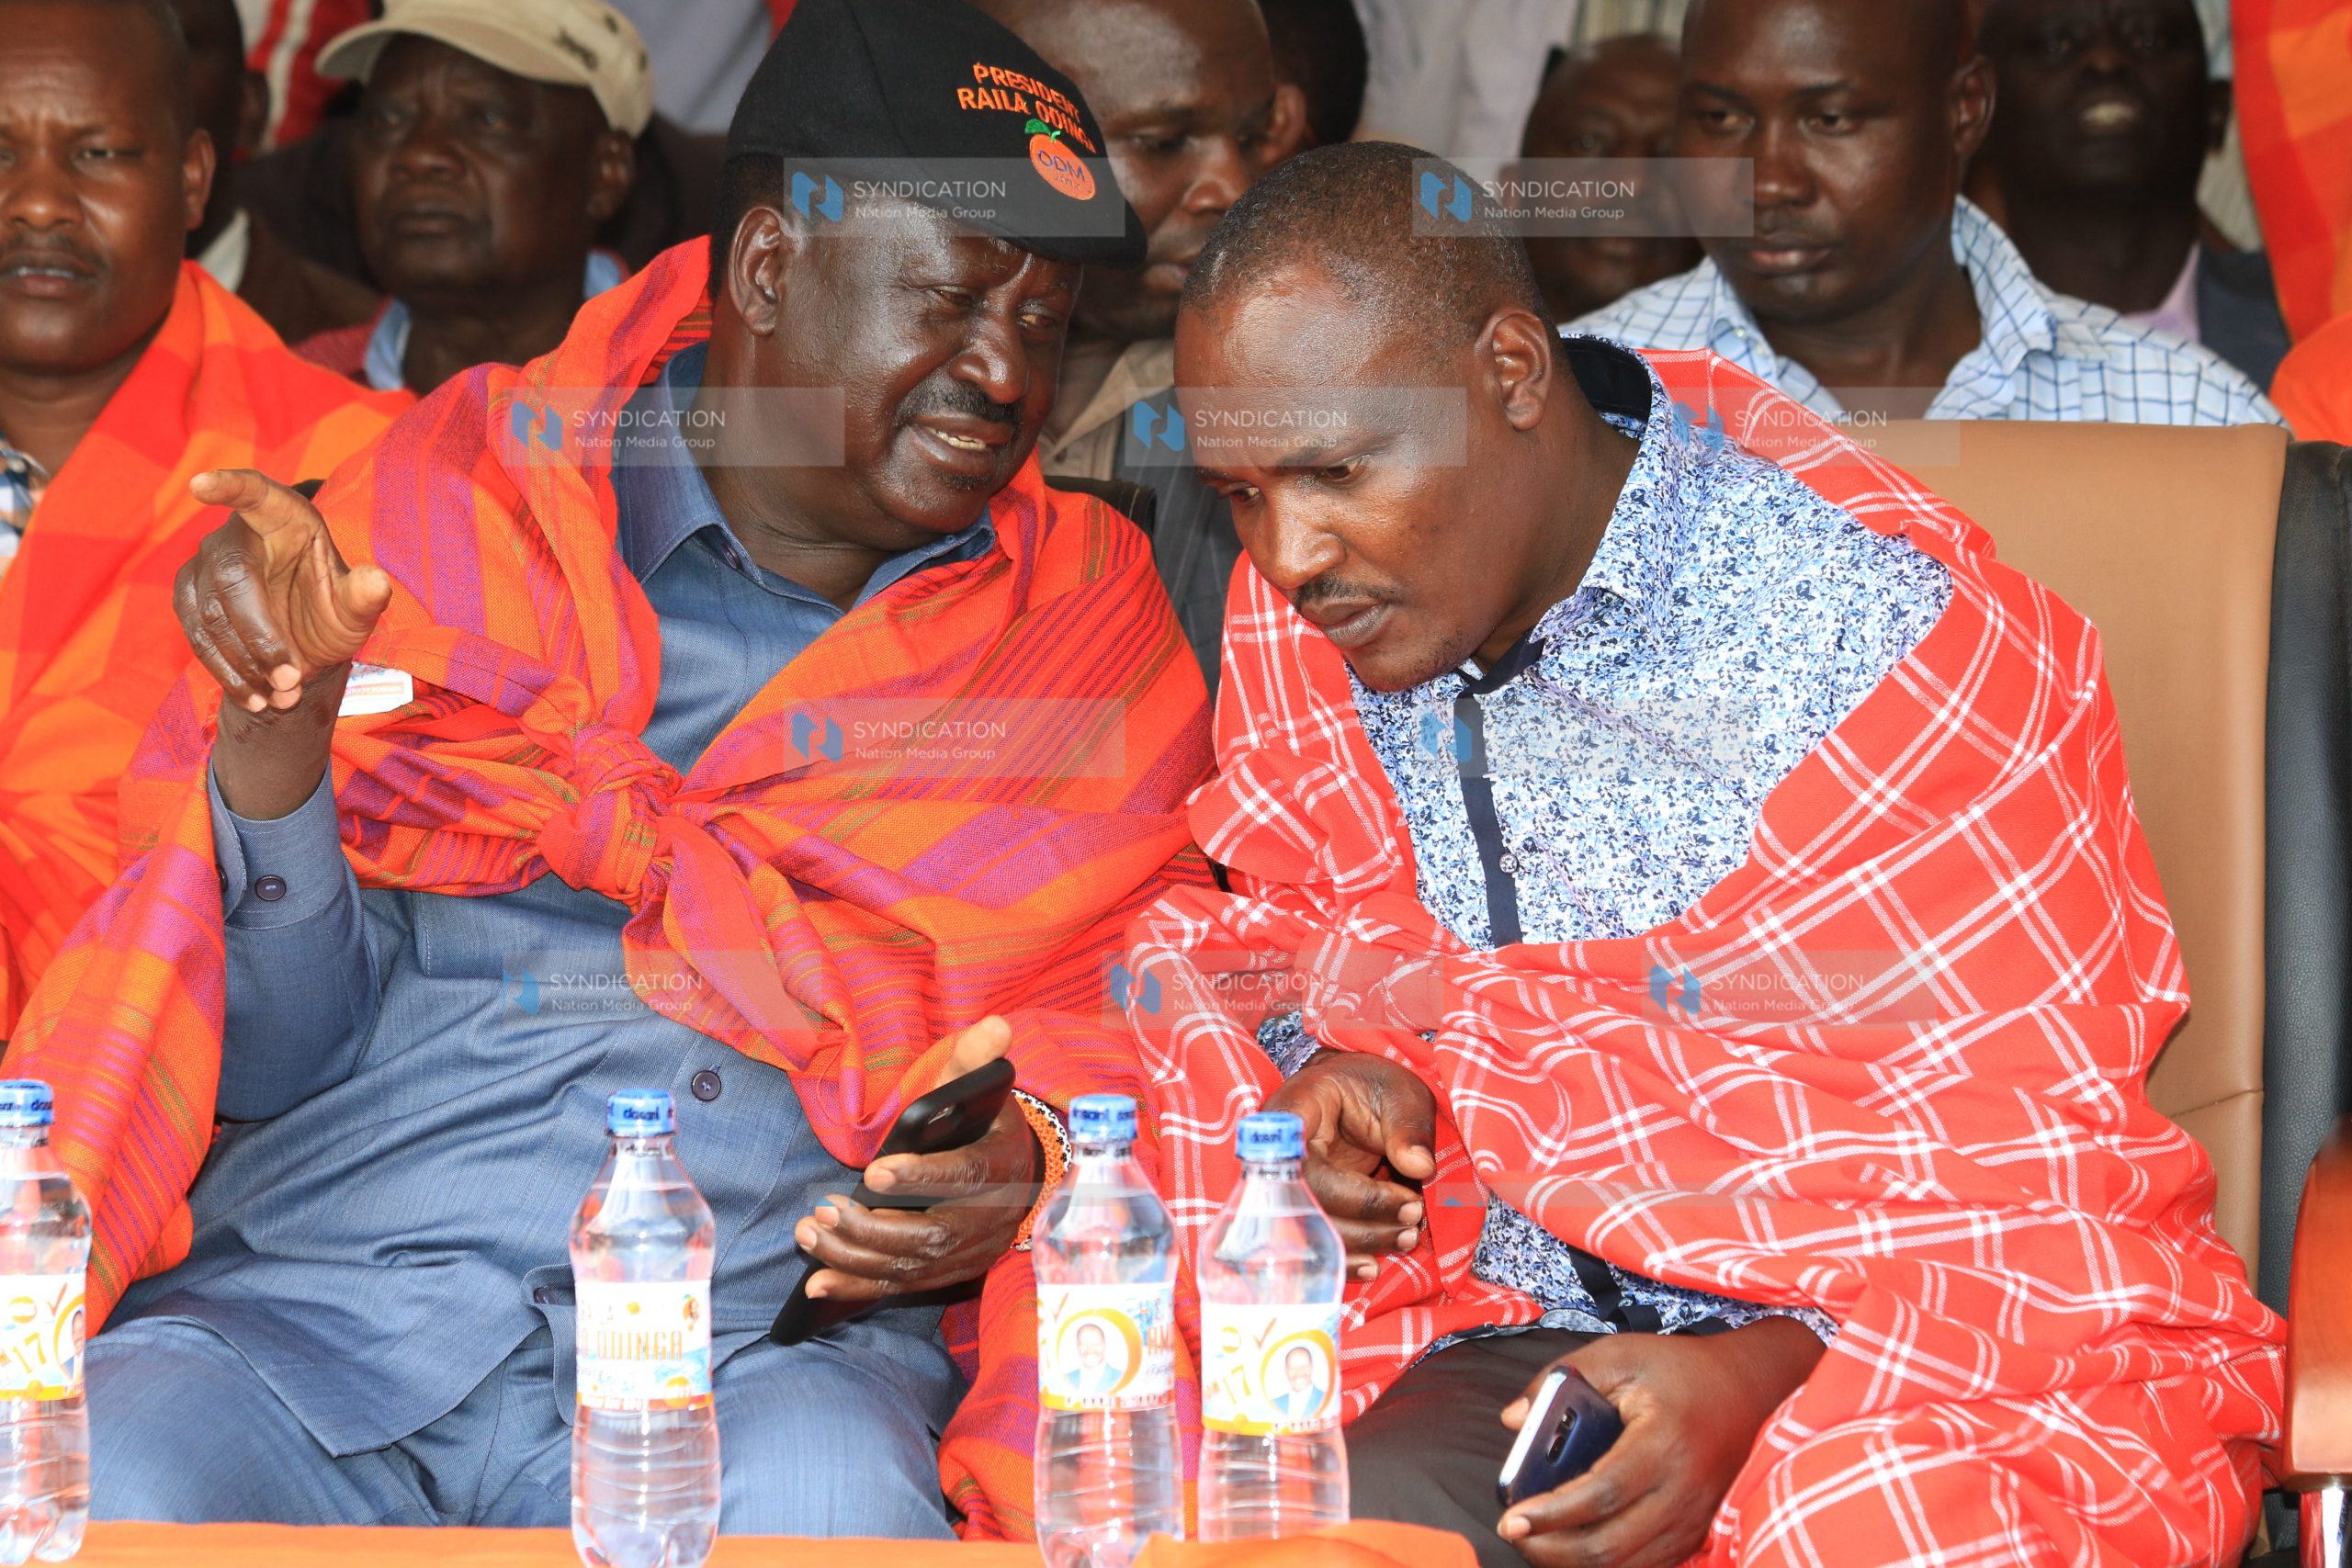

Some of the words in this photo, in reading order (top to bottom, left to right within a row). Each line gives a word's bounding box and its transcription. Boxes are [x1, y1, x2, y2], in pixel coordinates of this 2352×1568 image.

[956, 87, 1031, 115] RAILA
[972, 62, 1080, 123] PRESIDENT
[1037, 151, 1085, 183] ODM
